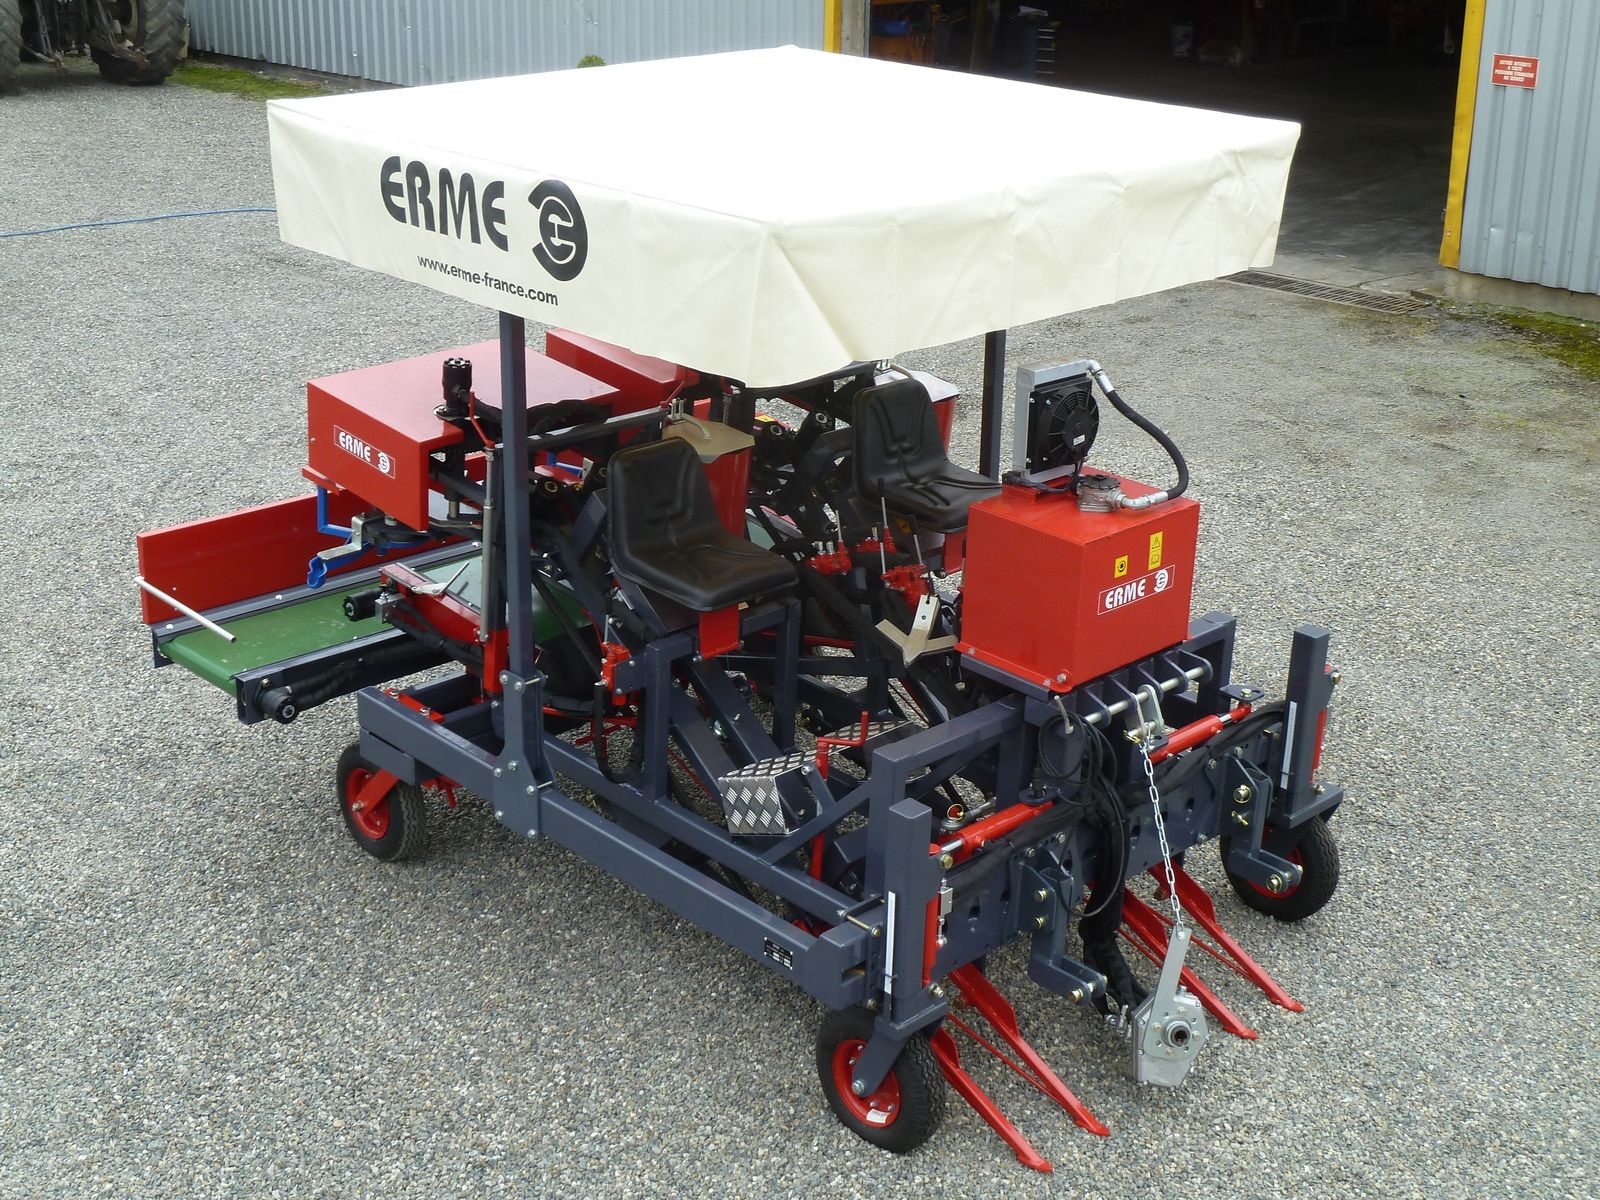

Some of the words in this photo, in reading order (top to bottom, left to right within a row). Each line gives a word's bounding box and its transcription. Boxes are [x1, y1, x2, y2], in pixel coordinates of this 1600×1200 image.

[380, 155, 509, 252] ERME
[417, 255, 559, 306] www.erme-france.com
[338, 431, 371, 463] ERME
[1105, 578, 1146, 609] ERME
